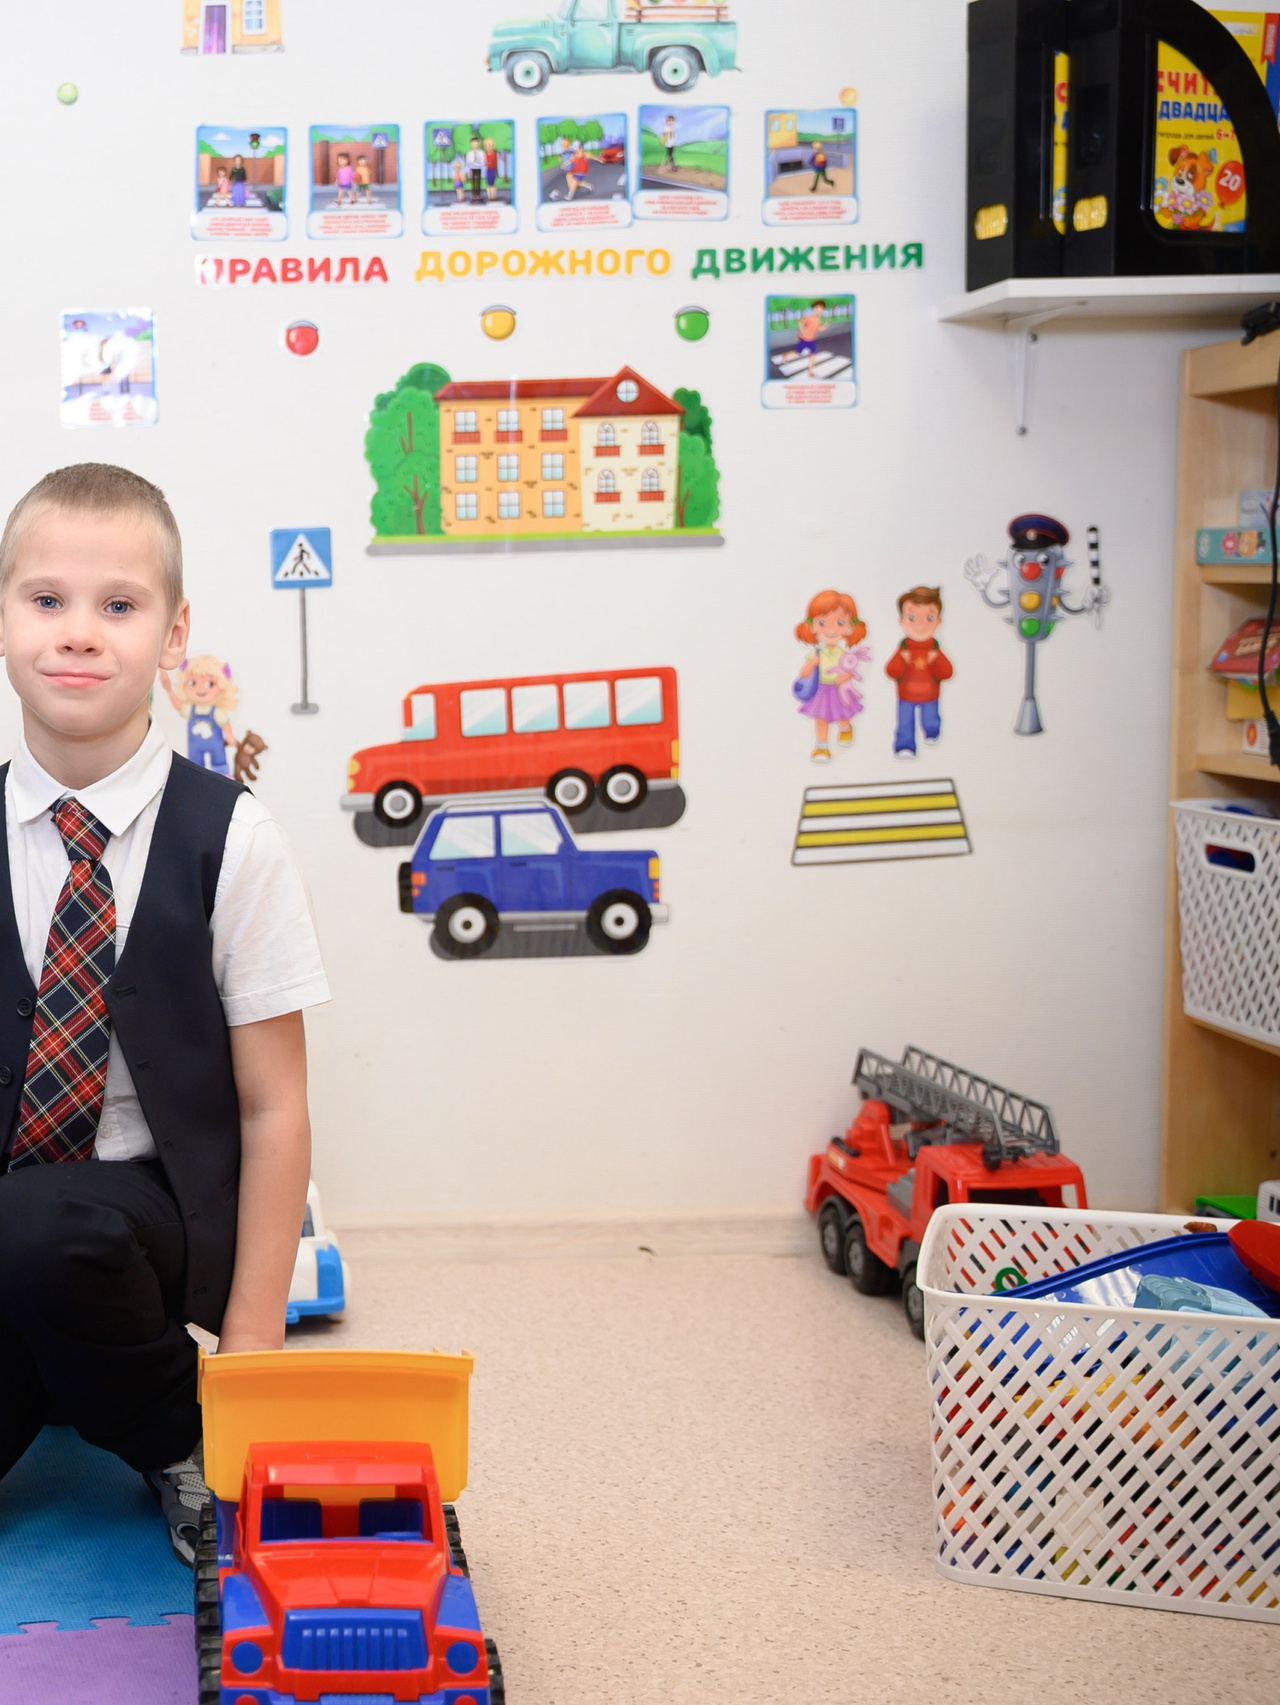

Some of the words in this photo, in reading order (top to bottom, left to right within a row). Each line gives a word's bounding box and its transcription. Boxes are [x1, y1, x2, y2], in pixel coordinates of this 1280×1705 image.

[1157, 70, 1217, 96] СЧИТ
[1219, 169, 1242, 191] 20
[200, 257, 389, 284] ПРАВИЛА
[415, 248, 672, 283] ДОРОЖНОГО
[690, 242, 924, 280] ДВИЖЕНИЯ
